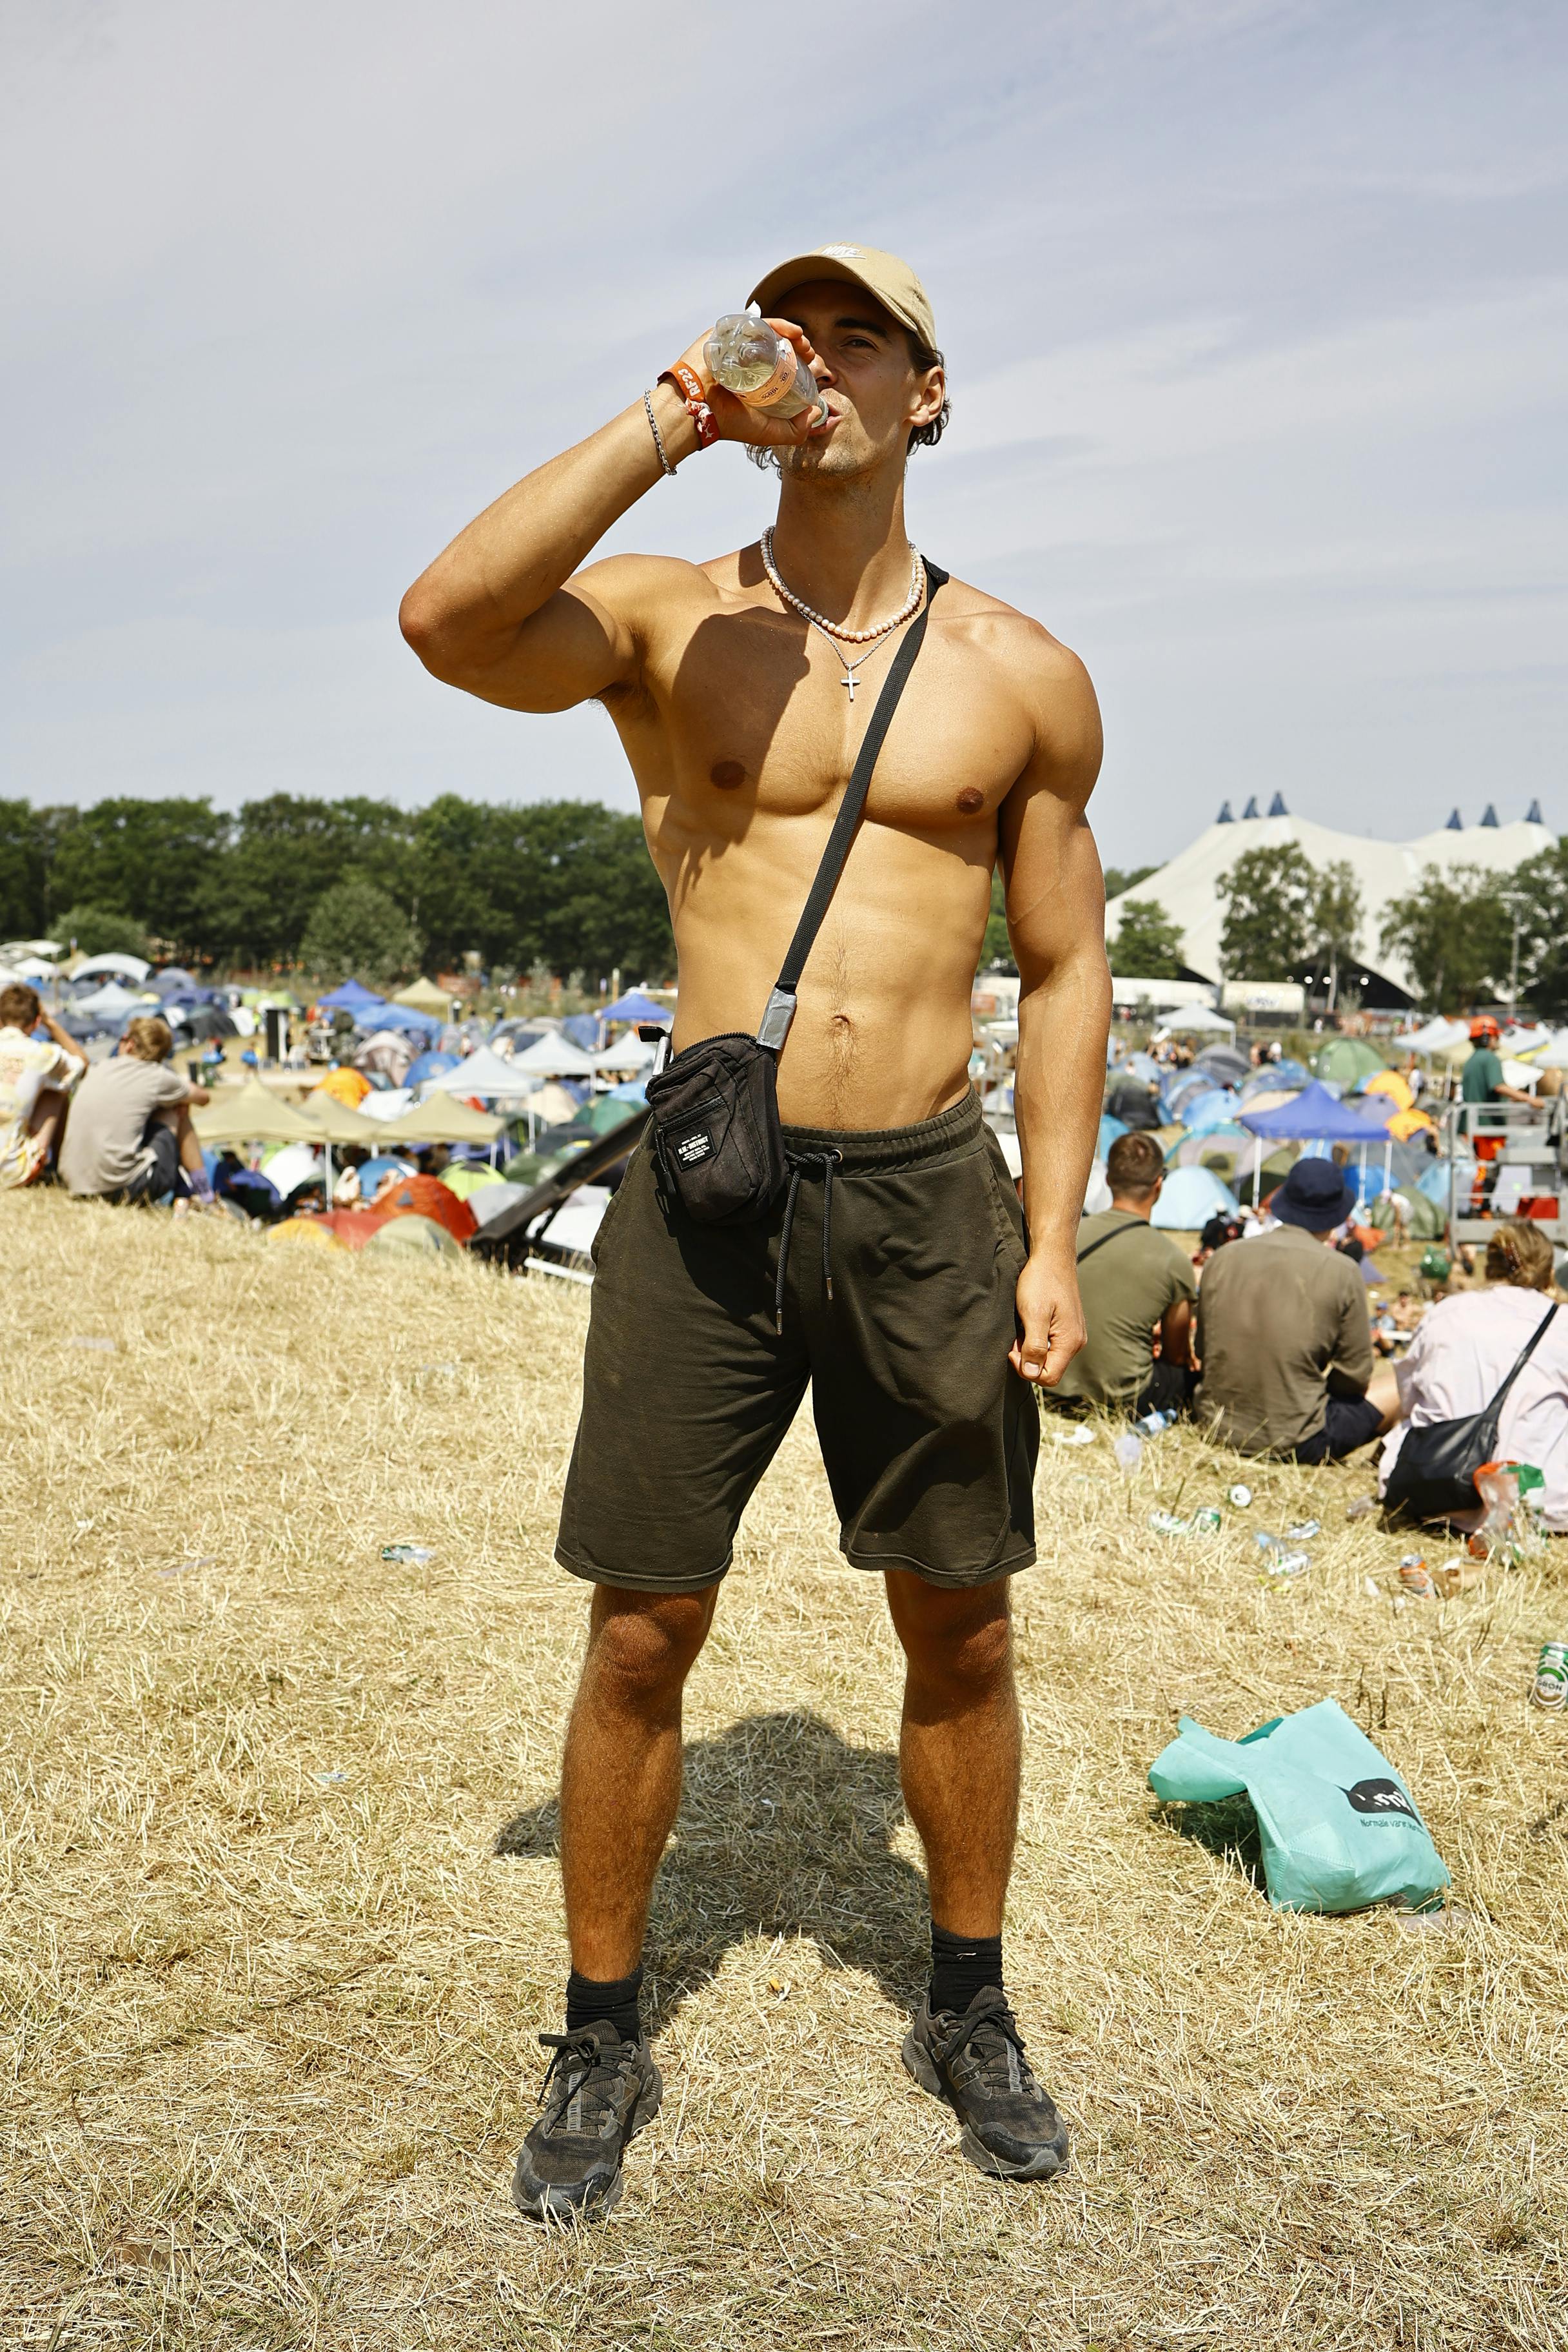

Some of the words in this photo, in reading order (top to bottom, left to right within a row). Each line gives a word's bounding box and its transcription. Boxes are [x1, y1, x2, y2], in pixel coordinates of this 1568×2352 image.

[821, 246, 861, 256] NIKE
[678, 368, 701, 397] RF23
[761, 387, 779, 399] 100%
[1359, 1818, 1389, 1828] Normale
